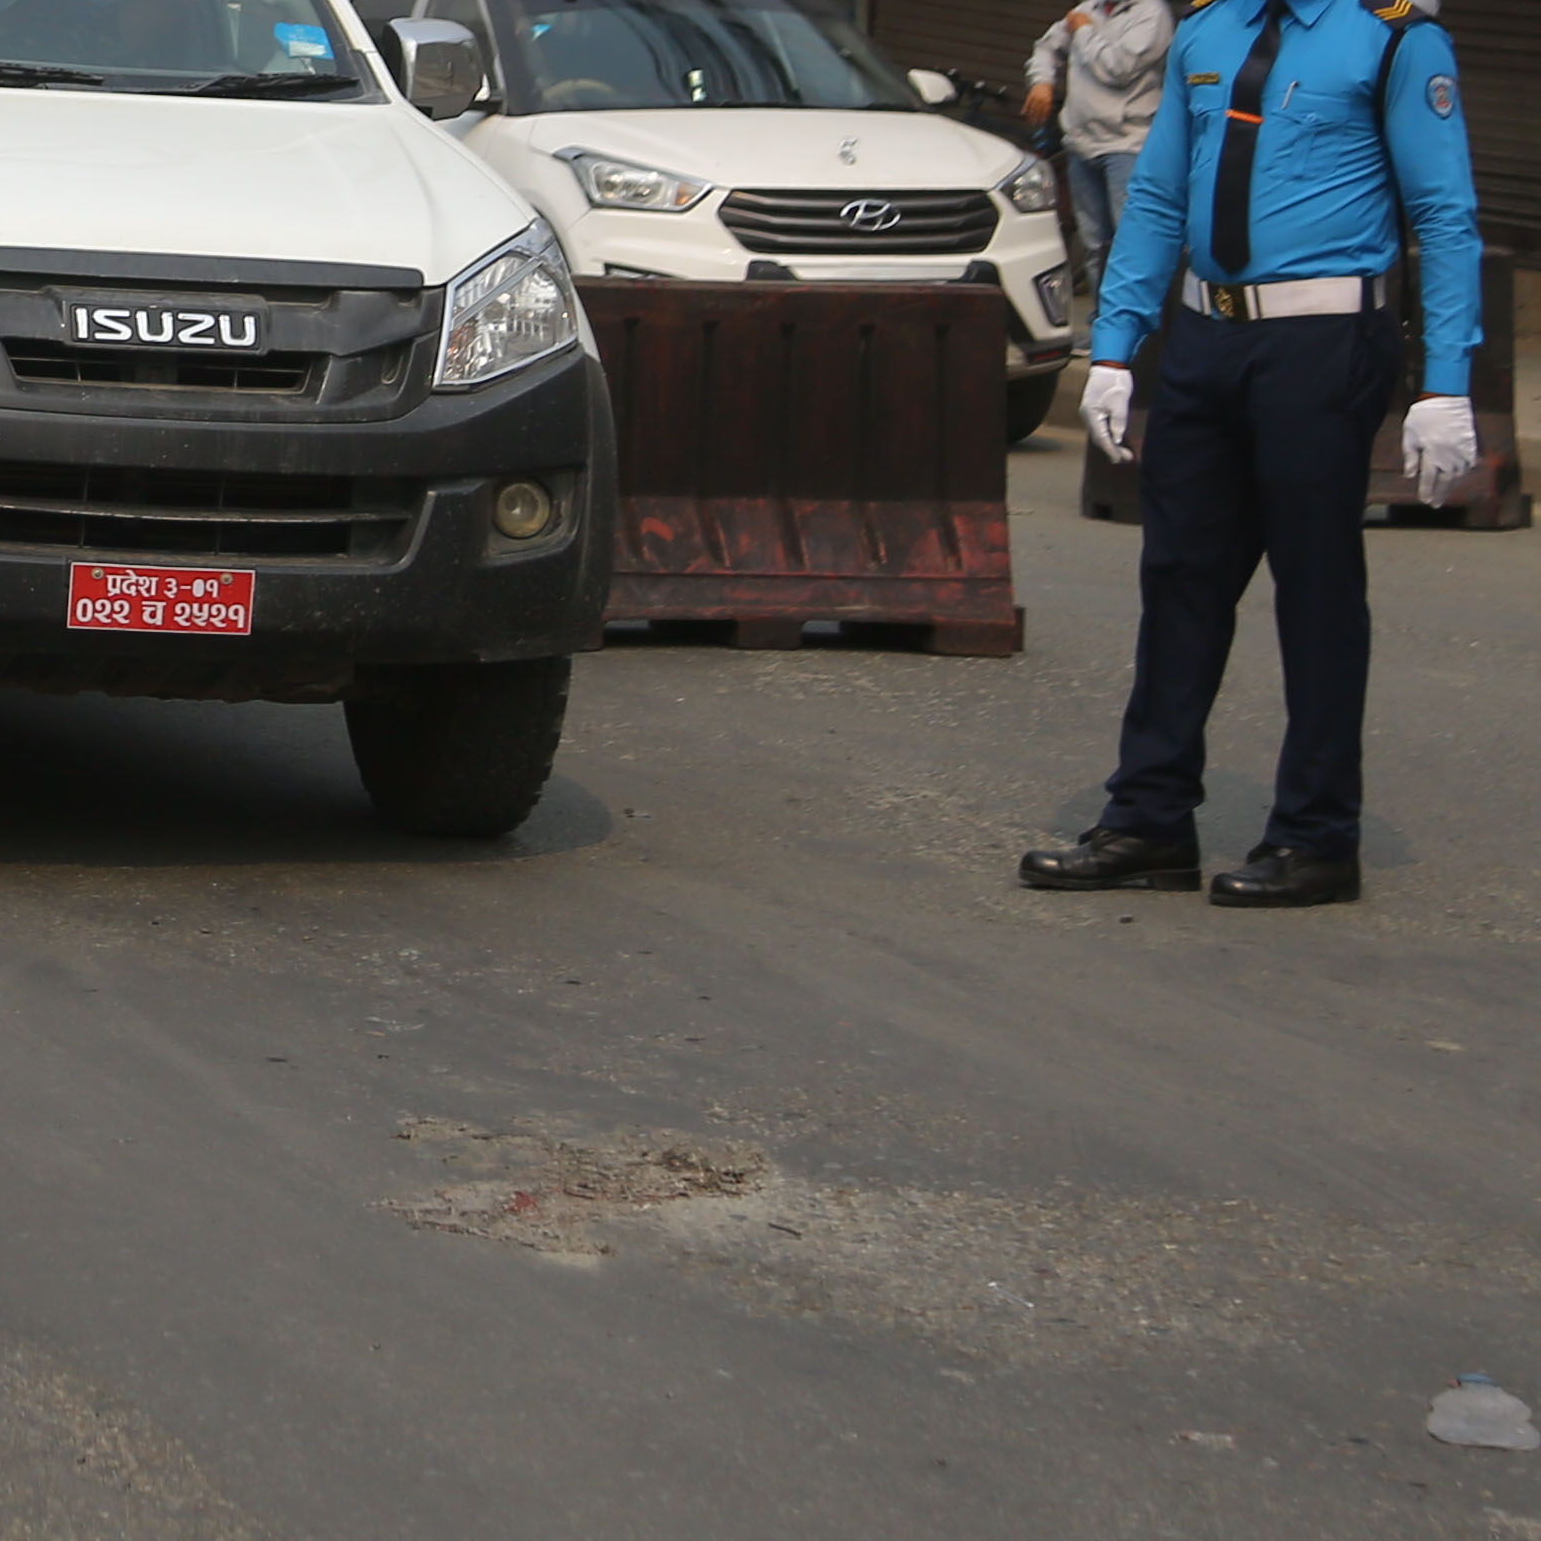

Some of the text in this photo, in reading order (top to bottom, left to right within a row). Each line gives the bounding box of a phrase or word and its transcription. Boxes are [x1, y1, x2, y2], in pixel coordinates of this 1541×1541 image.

[75, 306, 257, 348] ISUZU
[105, 570, 159, 598] प्रदेश
[140, 600, 167, 628] च
[173, 602, 247, 630] २५२१
